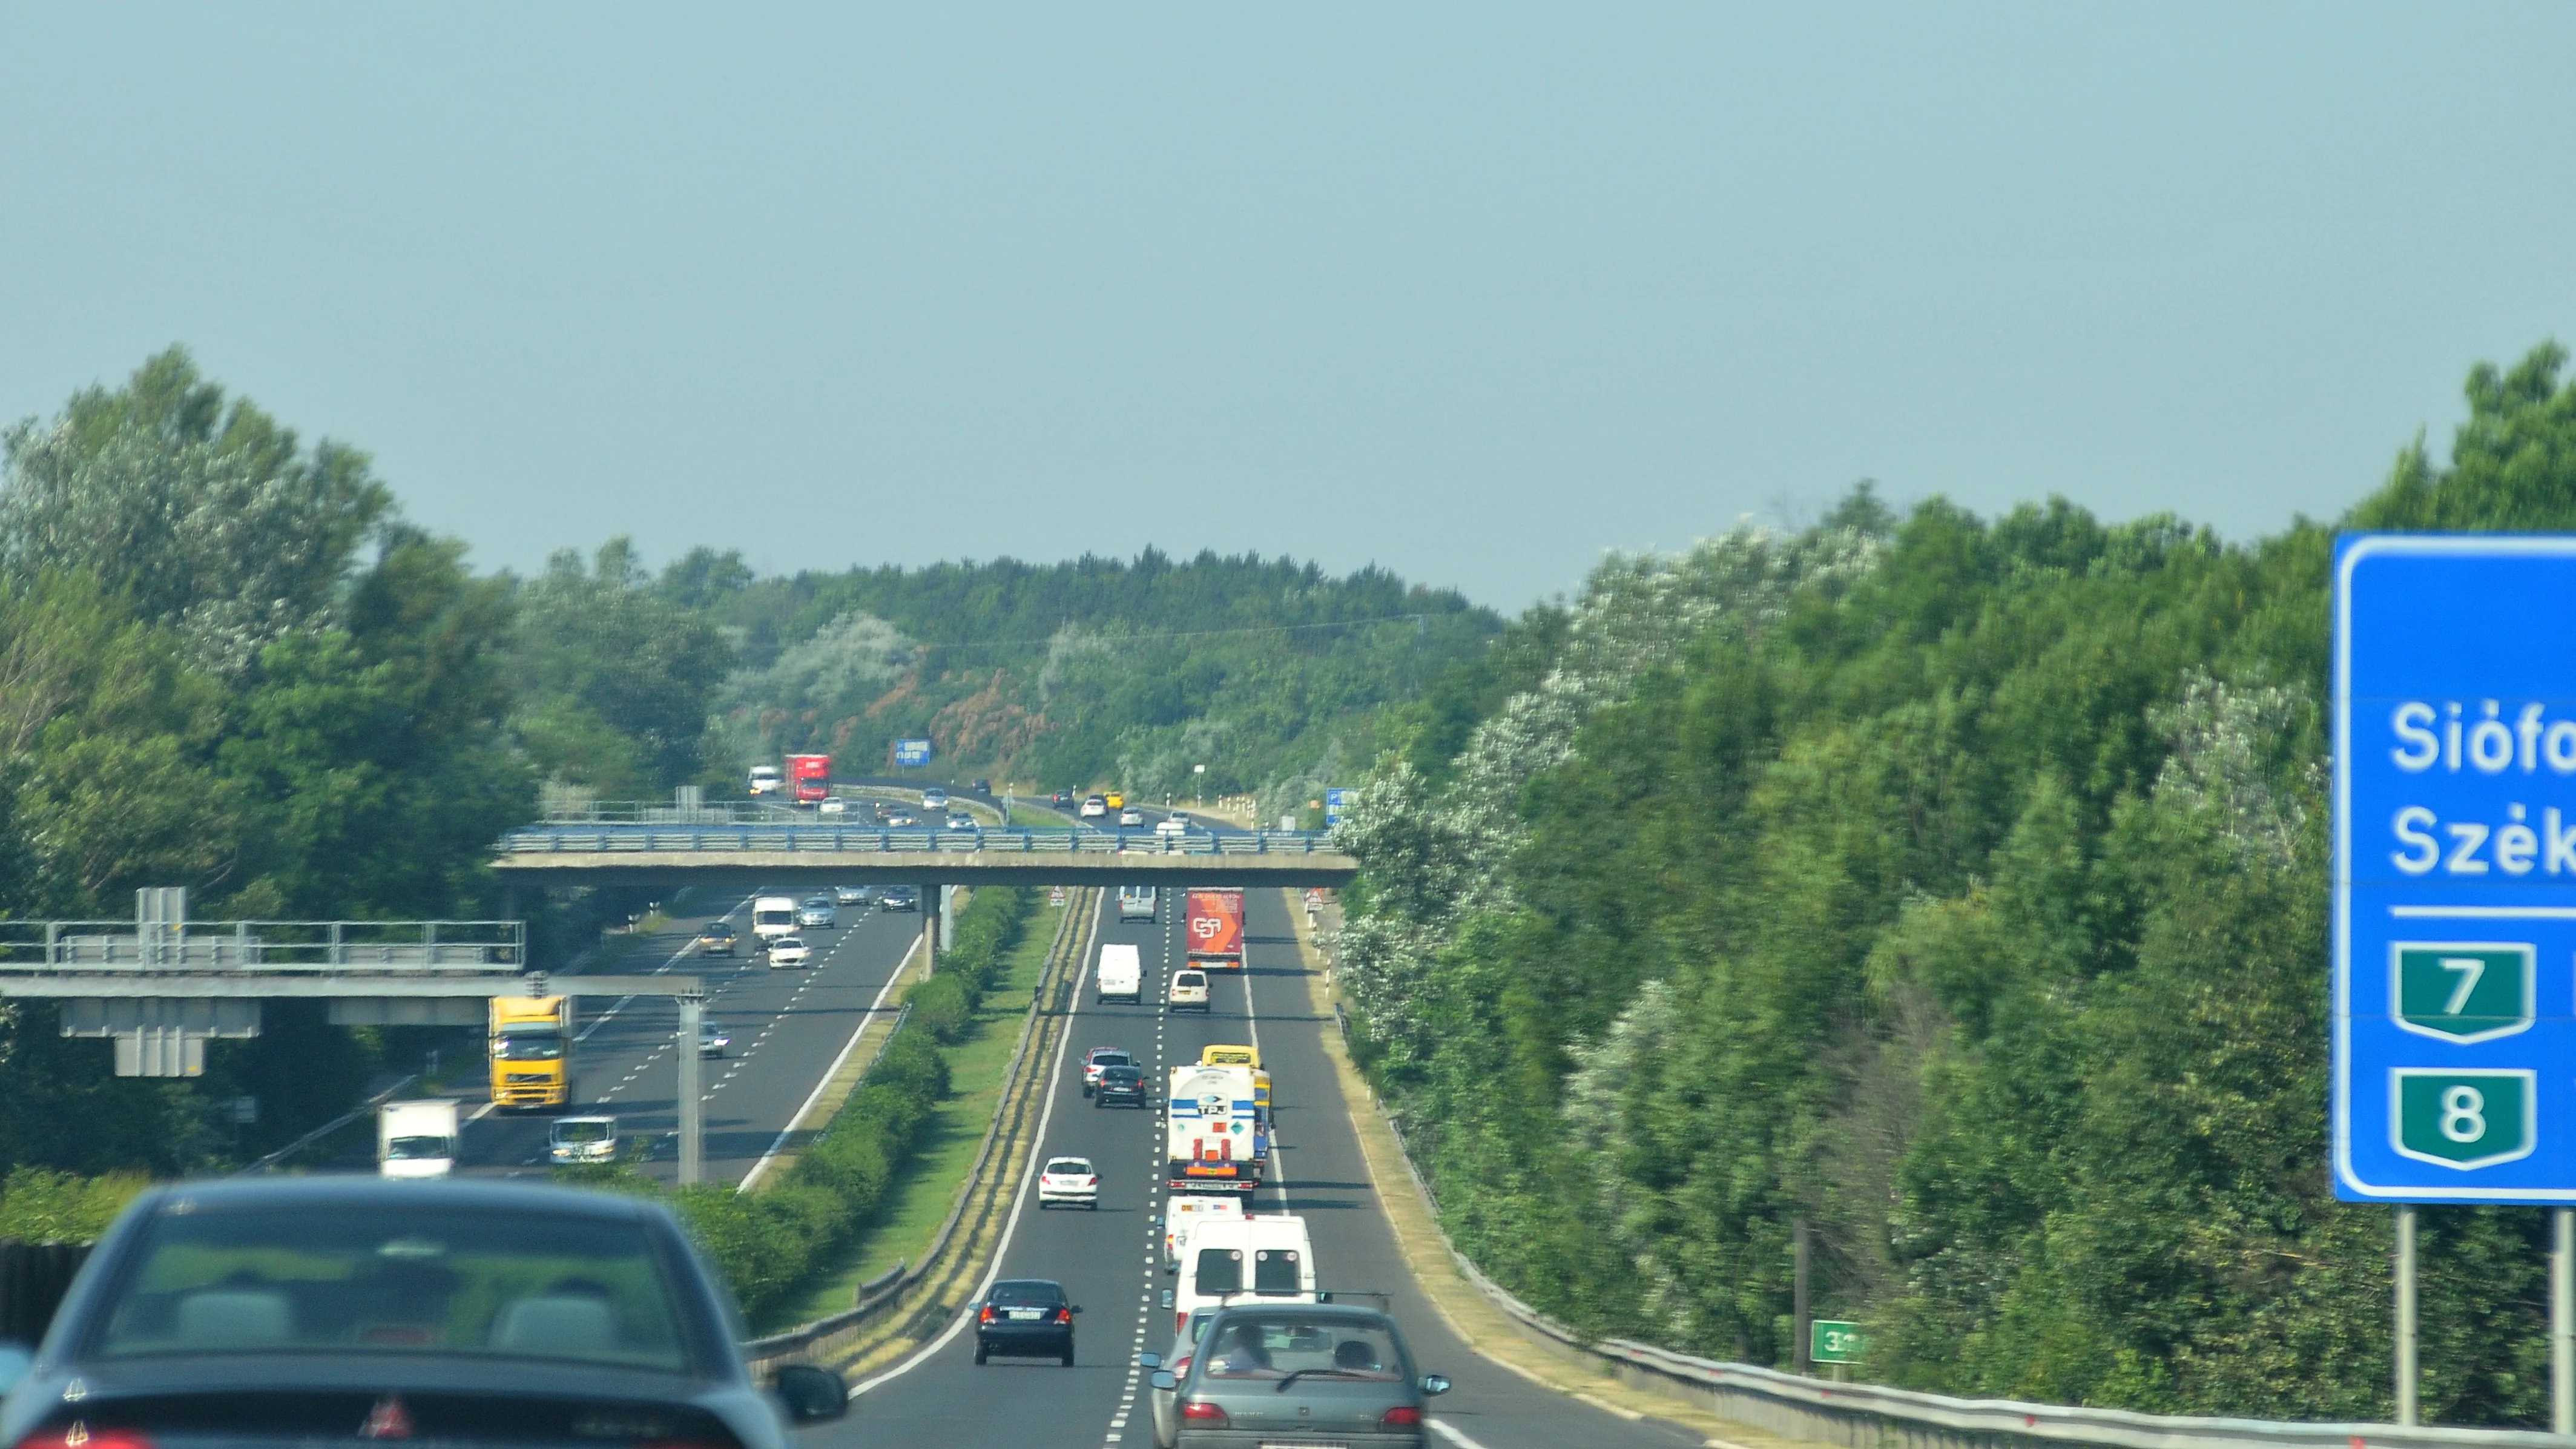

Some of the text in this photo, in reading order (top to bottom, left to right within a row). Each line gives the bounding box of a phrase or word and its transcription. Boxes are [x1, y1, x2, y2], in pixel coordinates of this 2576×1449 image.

[2440, 957, 2485, 1015] 7
[1198, 1106, 1227, 1114] TPJ
[2440, 1086, 2486, 1143] 8
